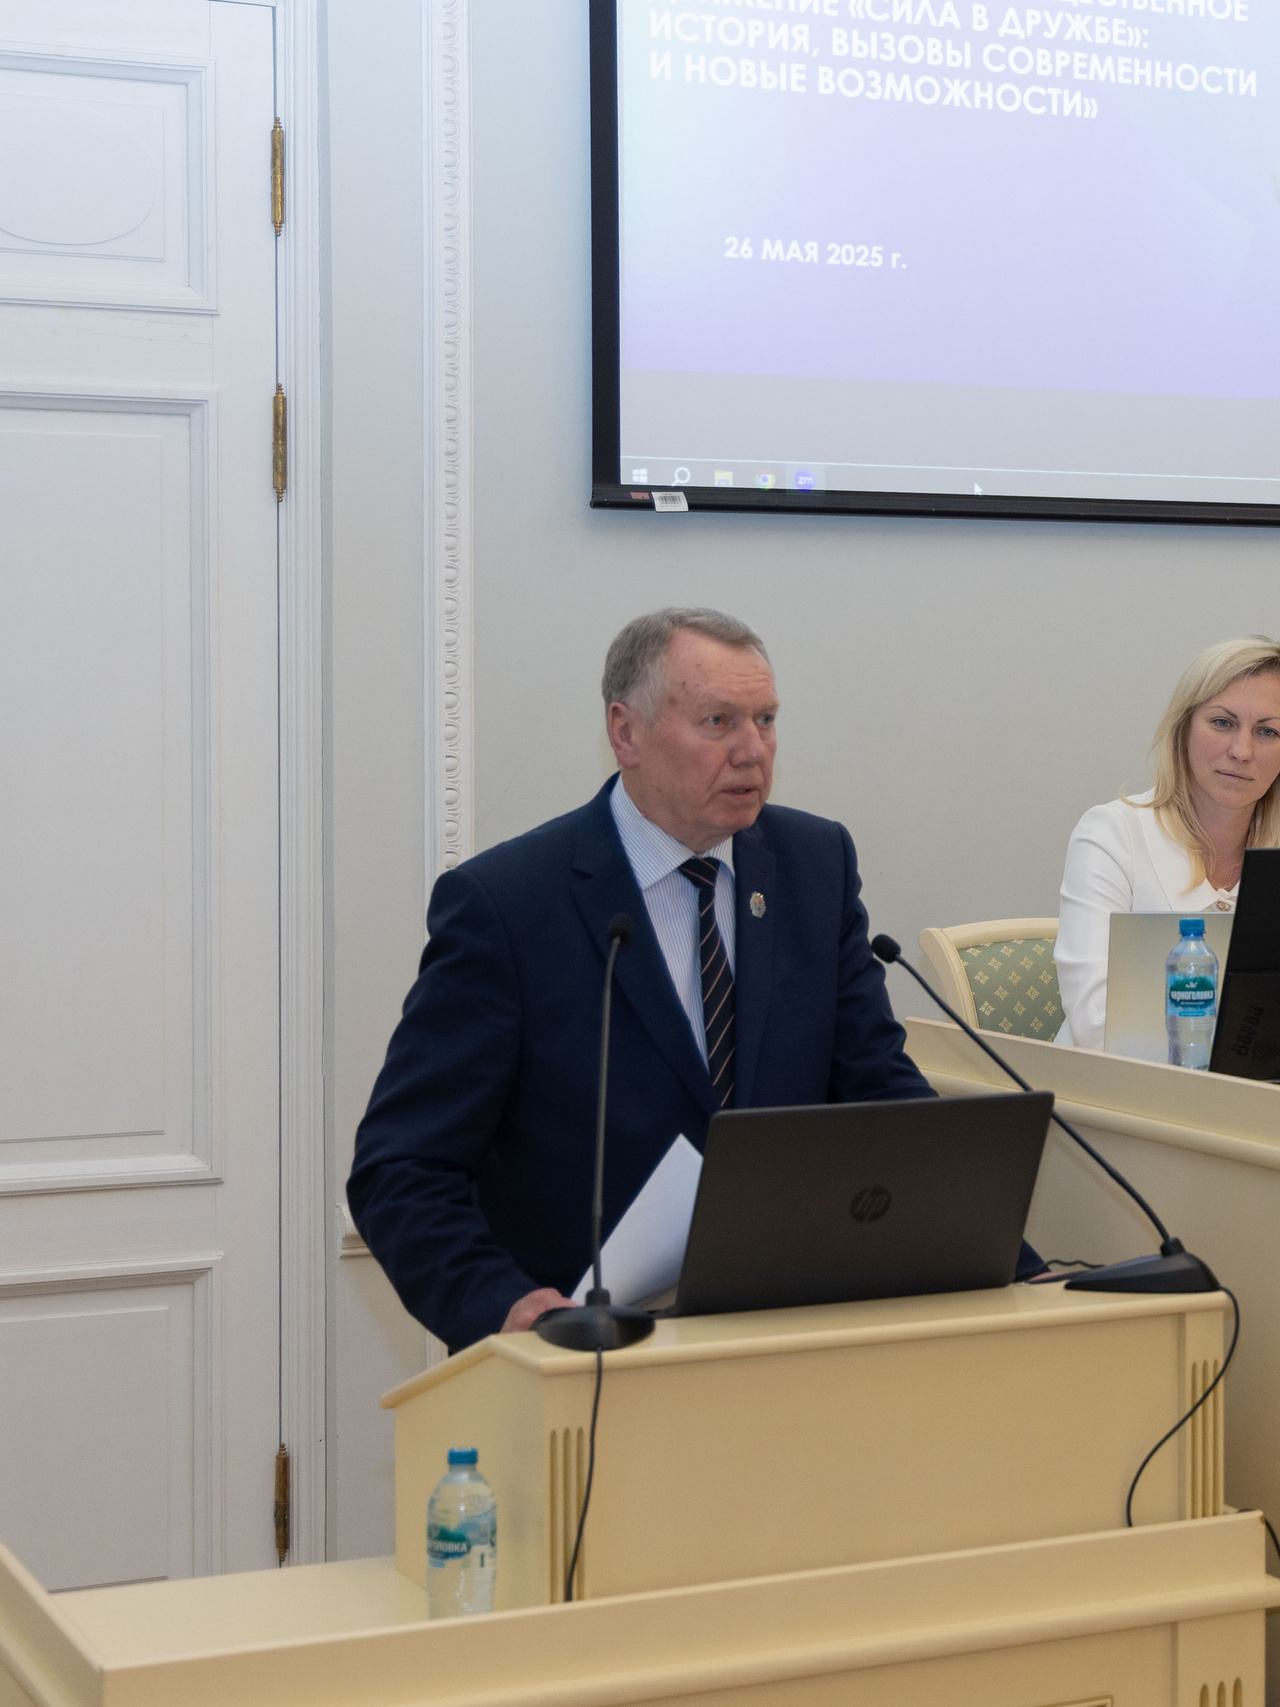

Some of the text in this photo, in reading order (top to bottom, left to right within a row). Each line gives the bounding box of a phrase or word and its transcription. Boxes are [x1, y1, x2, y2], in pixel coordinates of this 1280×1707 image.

[848, 0, 961, 29] «СИЛА
[972, 3, 989, 31] В
[998, 7, 1149, 49] ДРУЖБЕ»:
[650, 9, 1257, 96] ИСТОРИЯ, ВЫЗОВЫ СОВРЕМЕННОСТИ
[650, 51, 1098, 119] И НОВЫЕ ВОЗМОЖНОСТИ»
[724, 236, 908, 269] 26 МАЯ 2025 г.
[798, 476, 813, 485] zm
